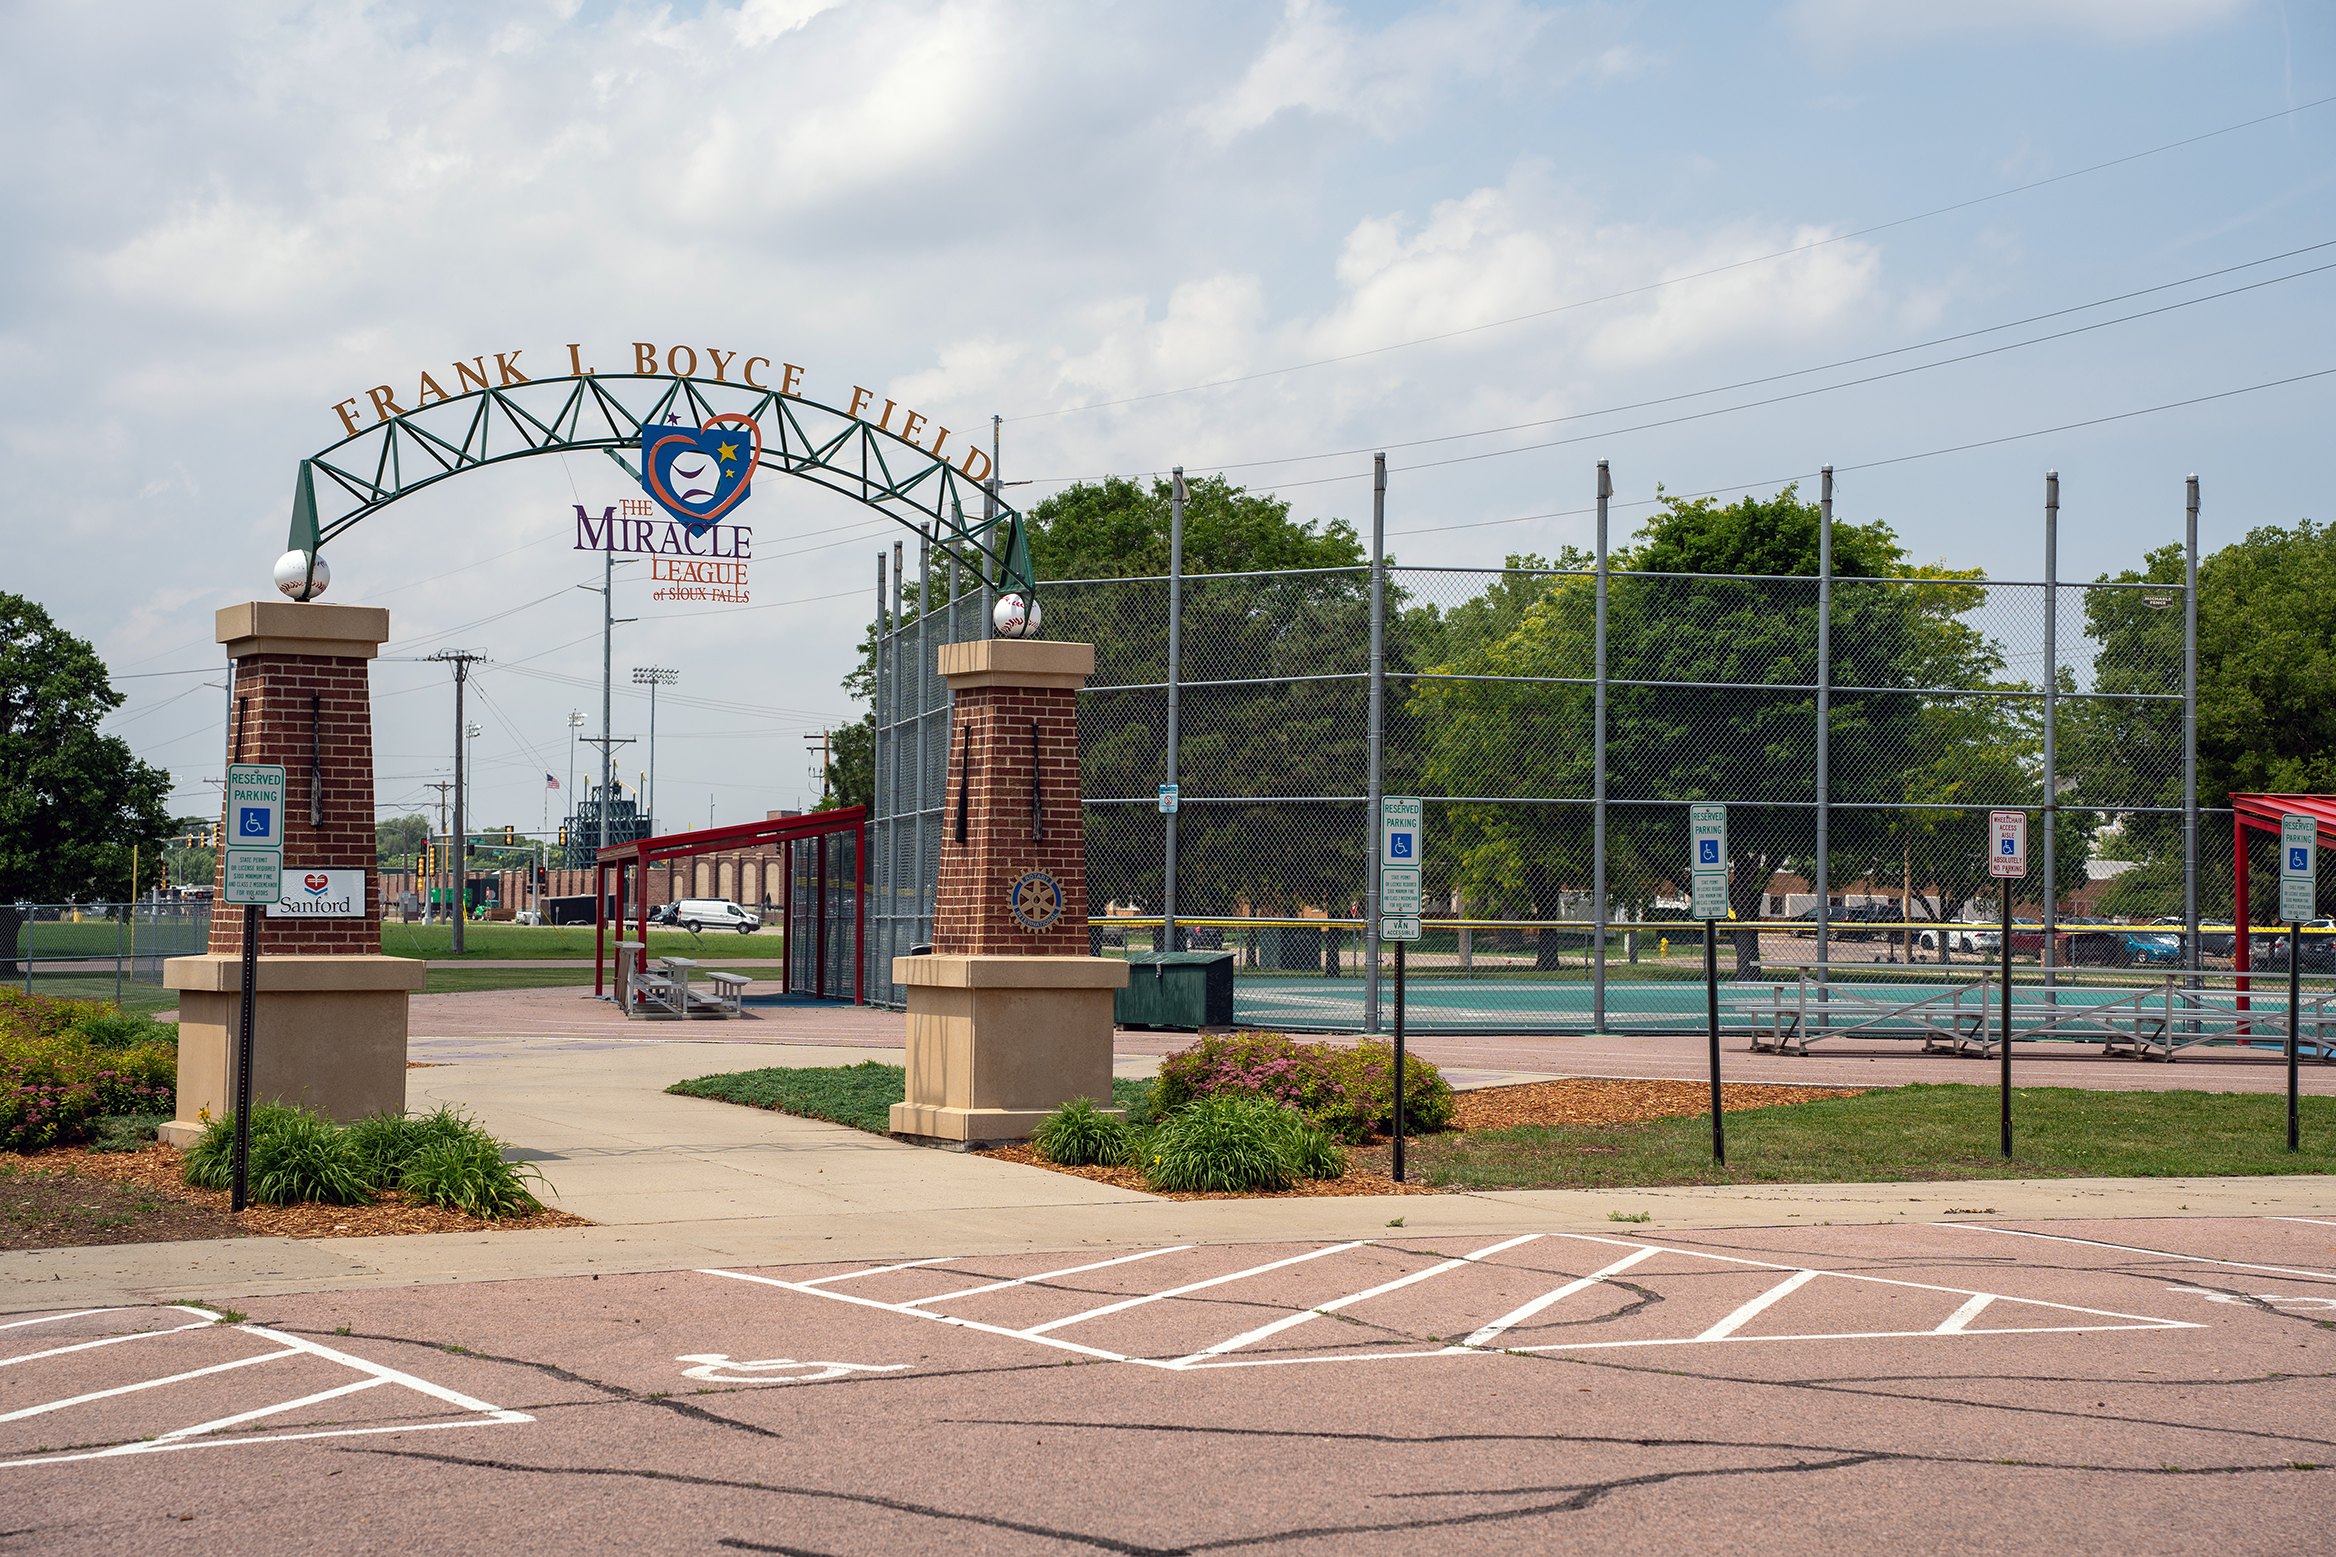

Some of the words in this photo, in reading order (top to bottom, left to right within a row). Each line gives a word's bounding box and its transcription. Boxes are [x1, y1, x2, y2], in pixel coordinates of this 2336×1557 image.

[331, 350, 531, 437] FRANK
[566, 343, 594, 377] L
[631, 342, 805, 399] BOYCE
[846, 384, 993, 483] FIELD
[619, 498, 654, 516] THE
[572, 504, 753, 559] MIRACLE
[651, 557, 749, 585] LEAGUE
[653, 588, 667, 601] of
[669, 586, 706, 601] SIOUX
[712, 588, 750, 604] FALLS
[231, 773, 281, 786] RESERVED
[234, 789, 277, 802] PARKING
[1384, 804, 1419, 814] RESERVED
[1693, 812, 1724, 821] RESERVED
[1386, 818, 1417, 828] PARKING
[2284, 821, 2314, 831] RESERVED
[1695, 825, 1722, 835] PARKING
[2286, 834, 2312, 844] PARKING
[252, 856, 268, 864] PERMIT
[2002, 864, 2022, 872] PARKING
[1024, 873, 1050, 882] ROTARY
[245, 889, 269, 897] VIOLATORS
[280, 896, 351, 914] Sanford
[1016, 910, 1058, 927] INTERNATIONAL
[1393, 922, 1409, 930] VAN
